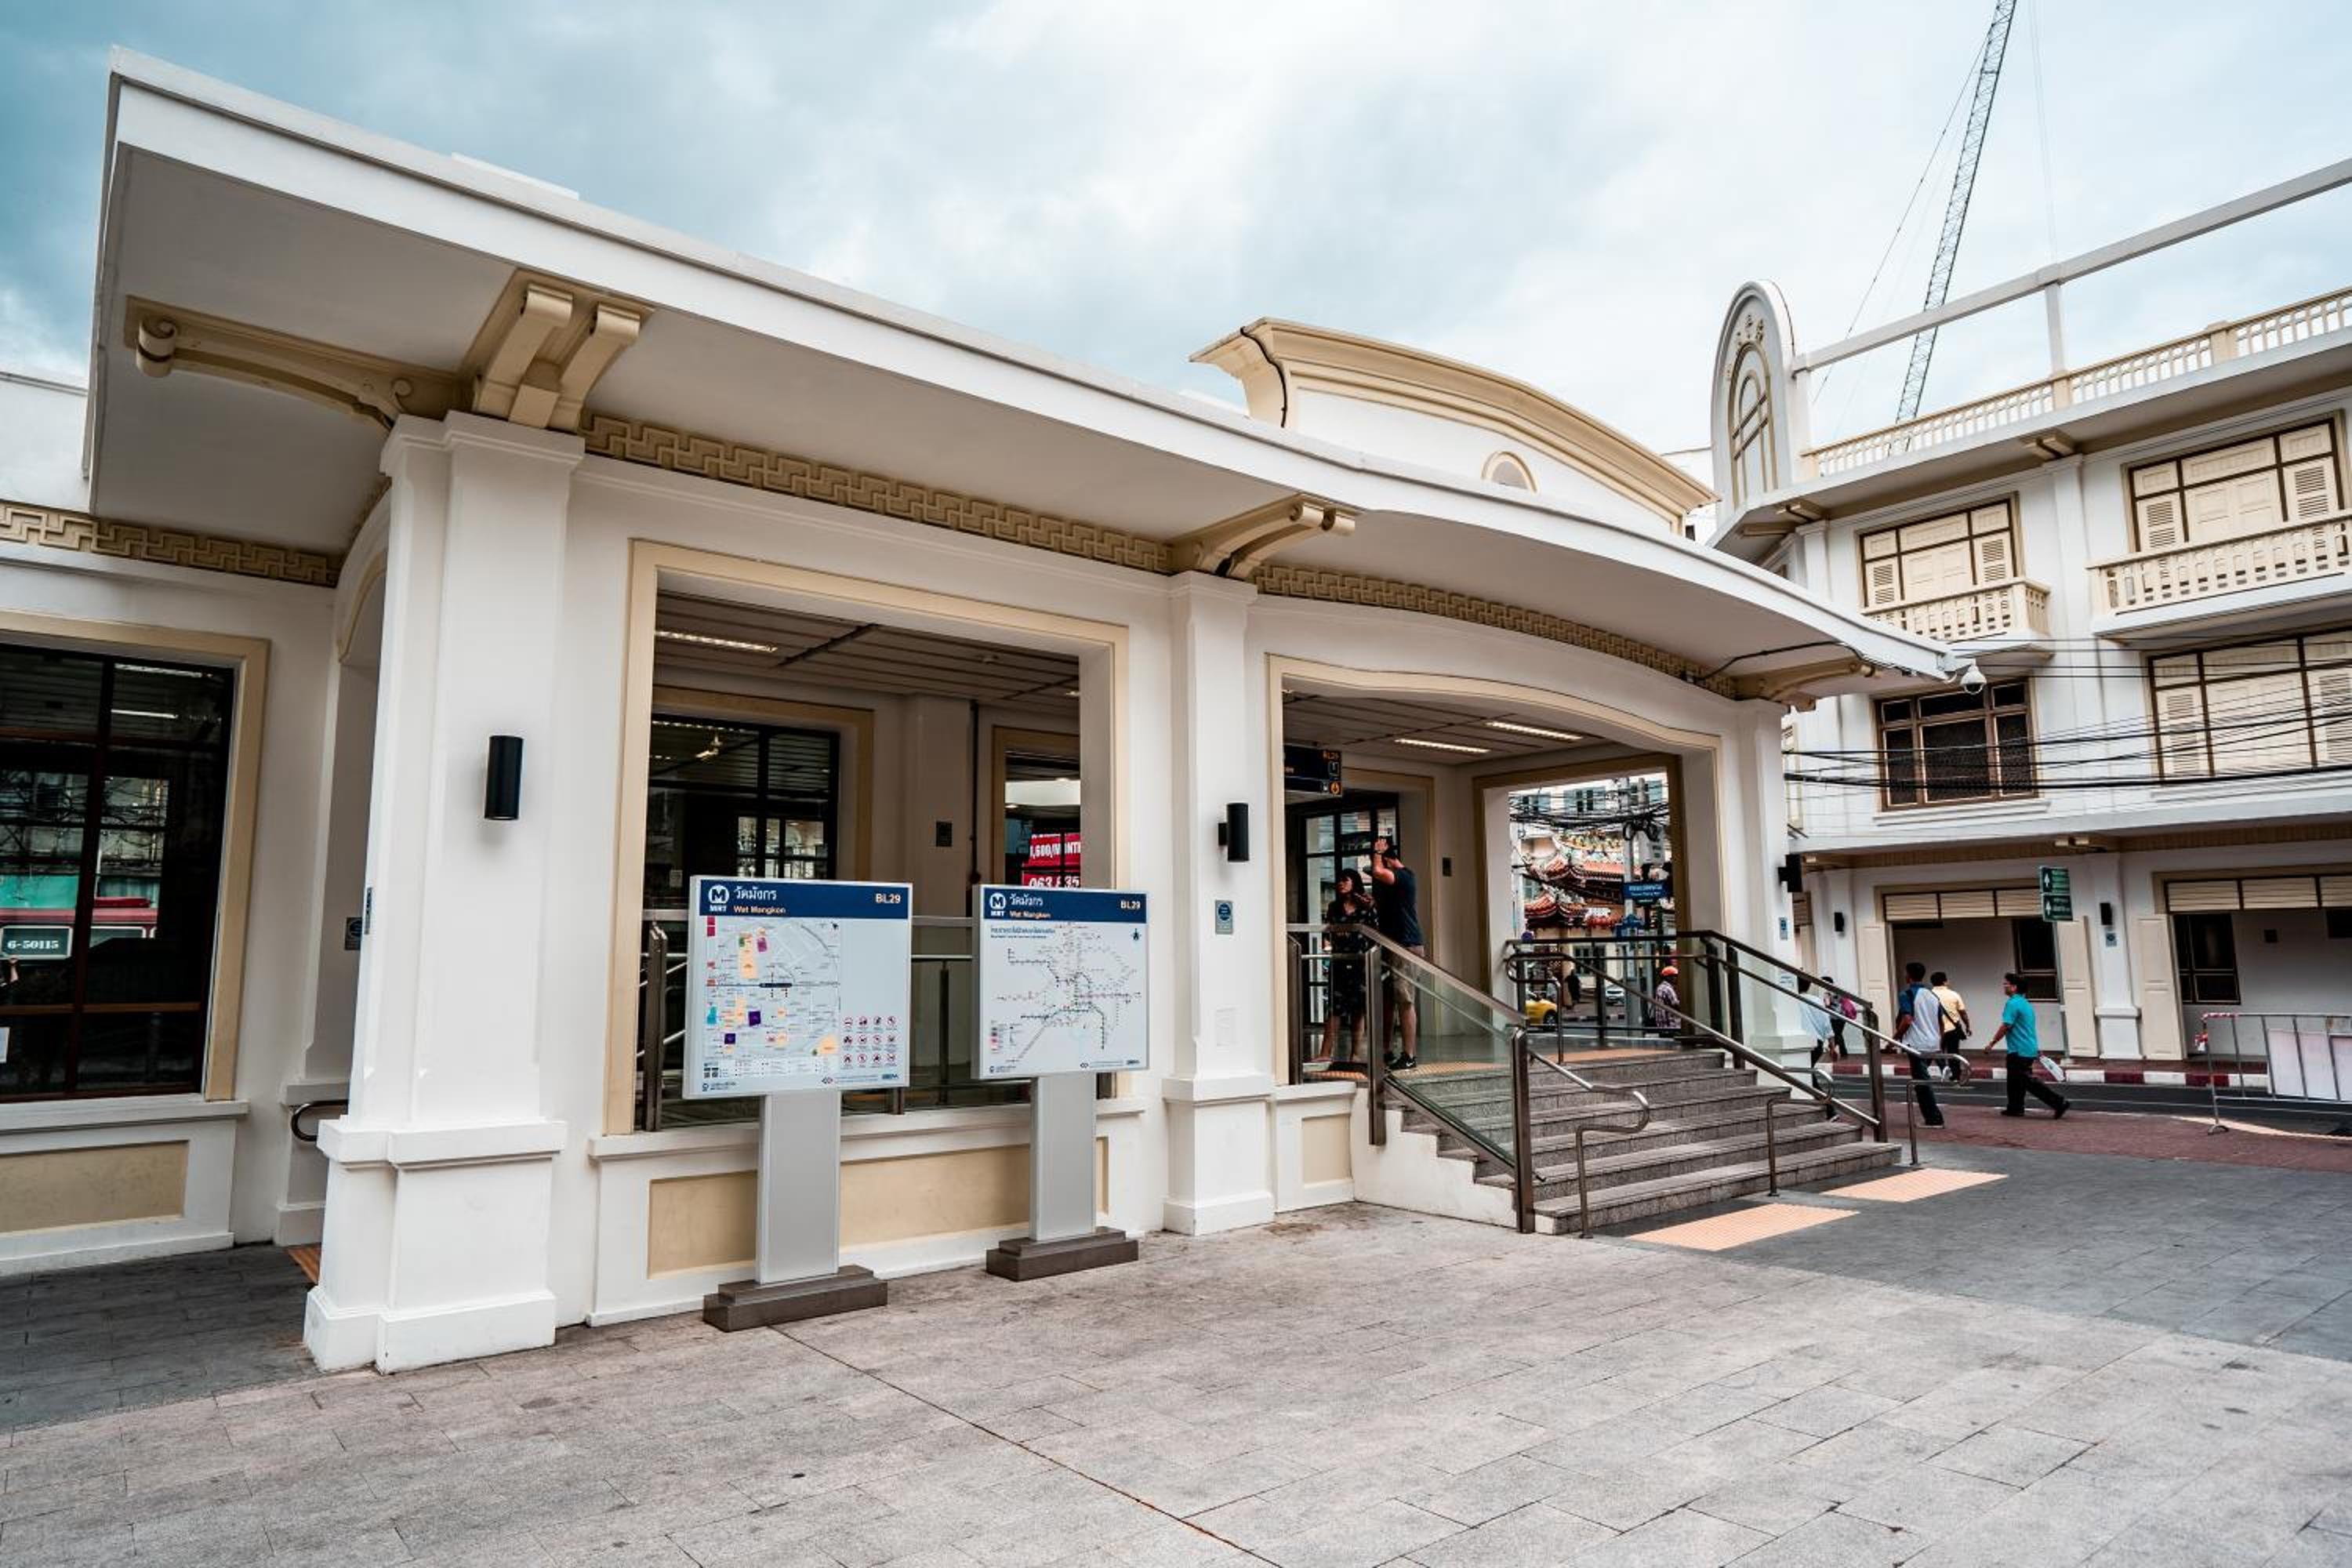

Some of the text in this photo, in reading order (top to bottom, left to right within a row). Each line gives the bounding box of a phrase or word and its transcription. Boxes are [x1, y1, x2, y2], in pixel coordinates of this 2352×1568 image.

[734, 886, 777, 900] วัดมังกร
[876, 893, 901, 903] BL29
[1009, 894, 1044, 906] วัดมังกร
[1120, 900, 1141, 909] BL29
[734, 905, 750, 913] Wat
[7, 940, 60, 950] 6-50115
